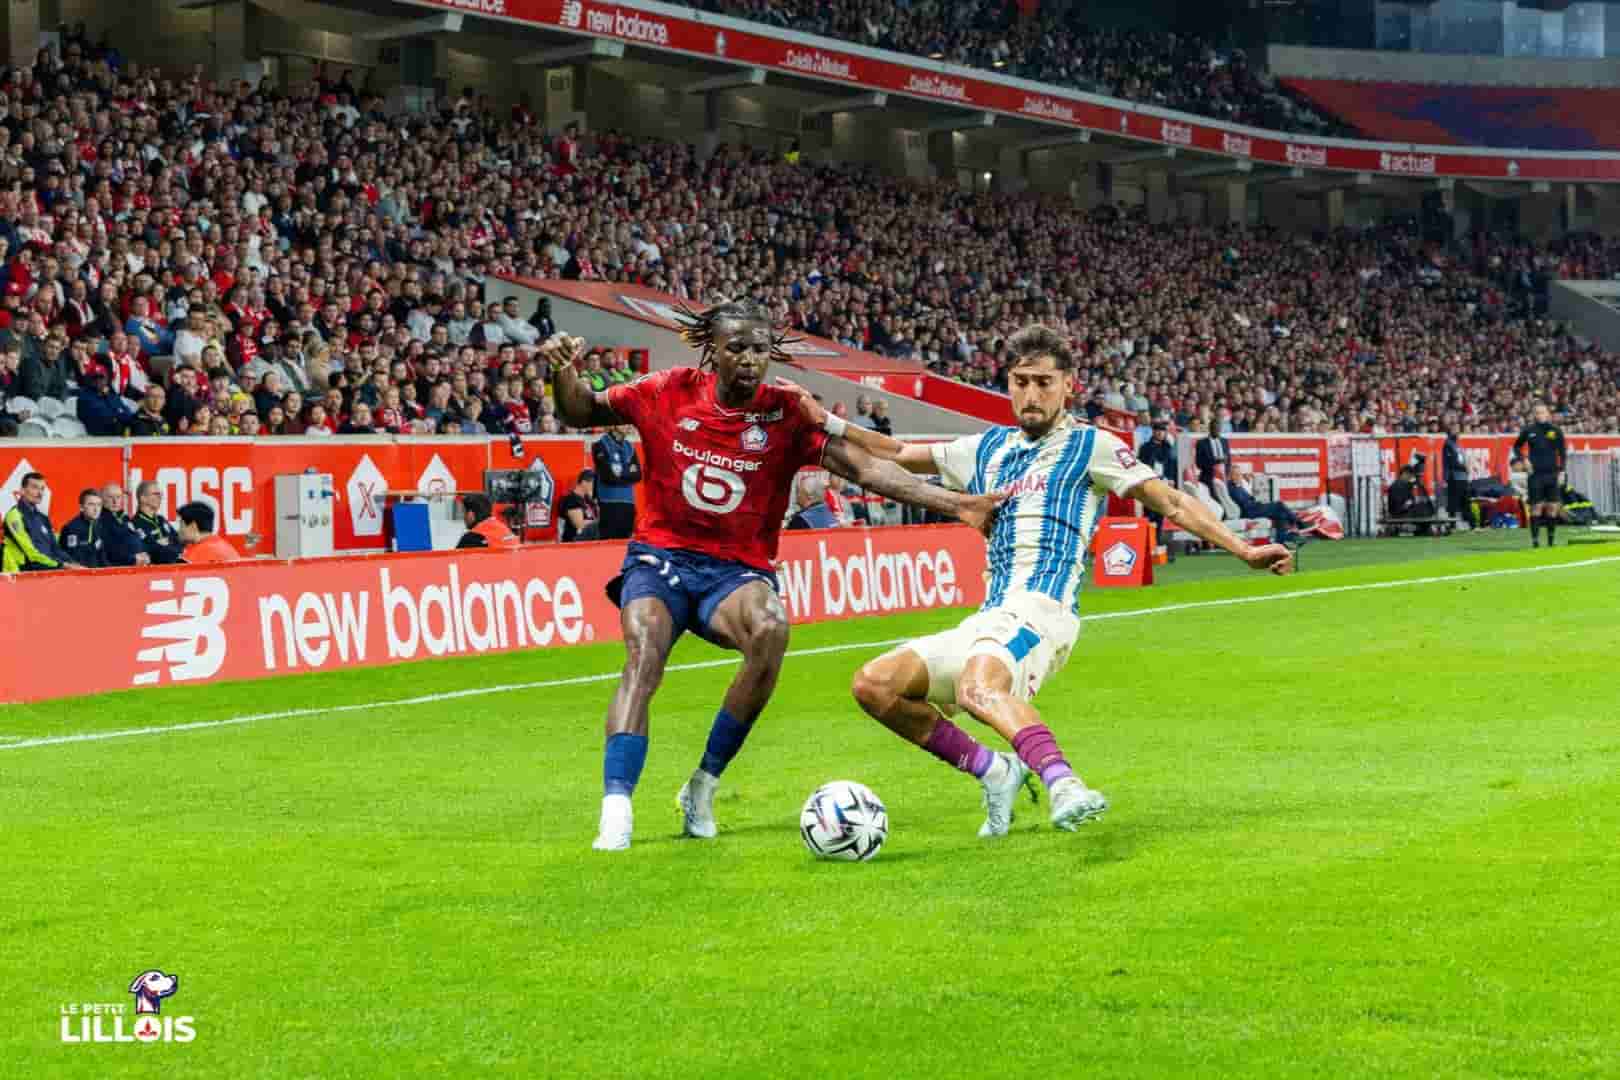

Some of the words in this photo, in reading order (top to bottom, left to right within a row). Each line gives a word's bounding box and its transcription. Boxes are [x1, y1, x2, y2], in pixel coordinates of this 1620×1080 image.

[587, 10, 615, 34] new
[615, 9, 667, 43] balance
[1391, 156, 1436, 174] actual
[672, 439, 763, 473] boulanger
[818, 537, 956, 615] balance
[258, 590, 370, 670] new
[380, 562, 584, 659] balance
